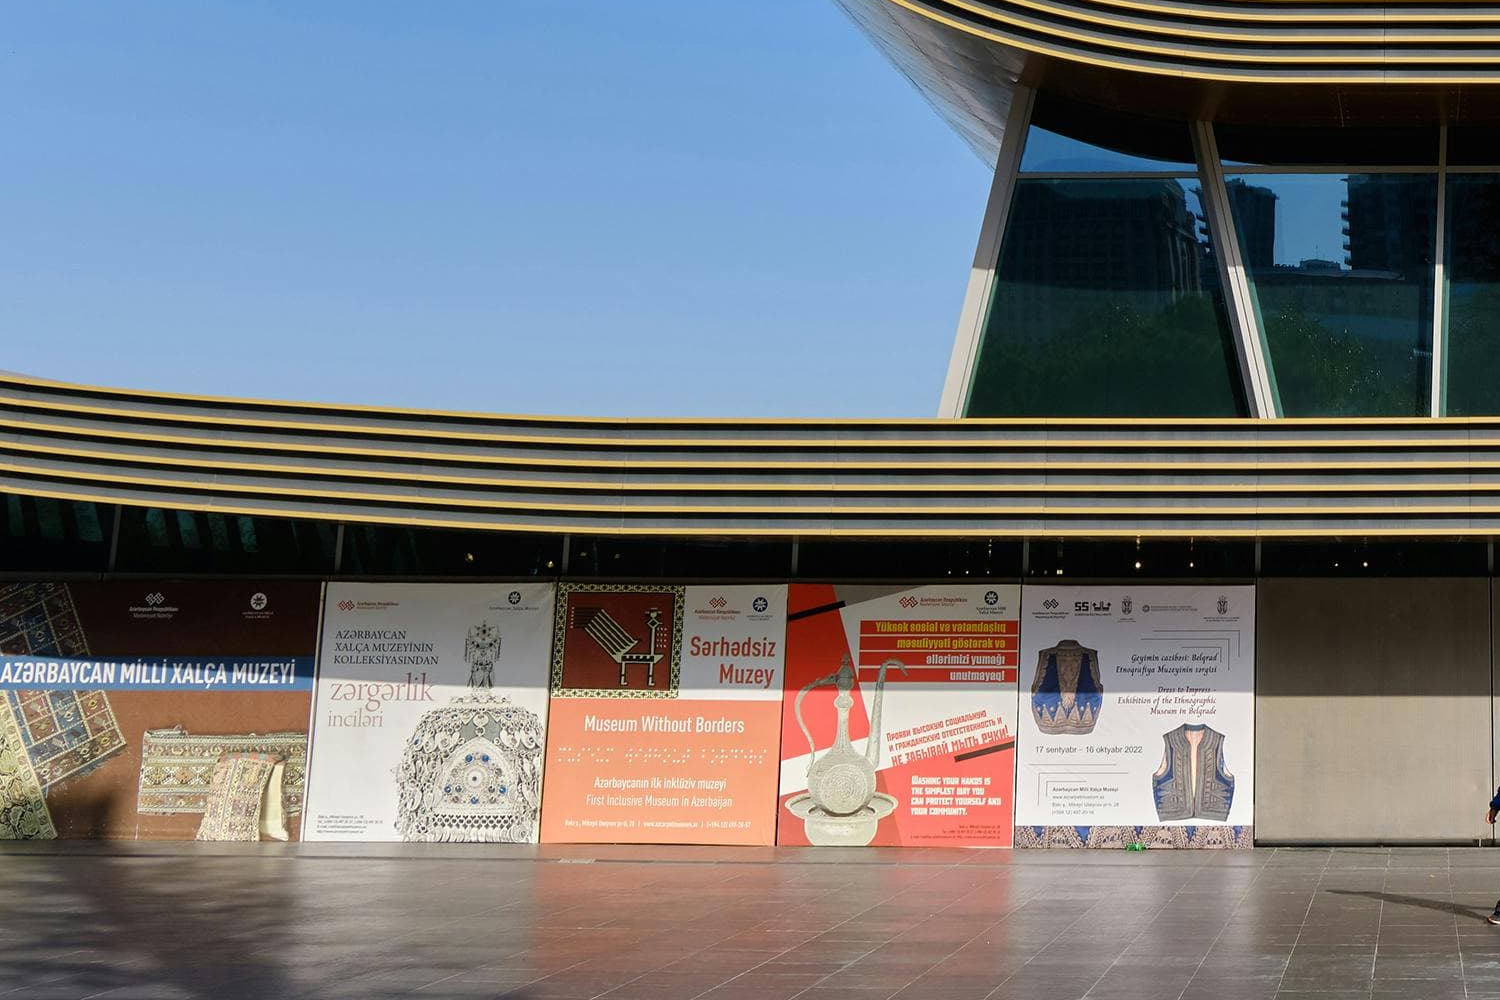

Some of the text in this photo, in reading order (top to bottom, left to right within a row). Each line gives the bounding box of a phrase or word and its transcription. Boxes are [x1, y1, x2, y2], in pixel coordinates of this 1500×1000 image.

[335, 630, 407, 640] AZƏRBAYCAN
[334, 641, 434, 654] XALÇA MUZEYİNİN
[690, 635, 777, 657] Sərhədsiz
[333, 654, 439, 665] KOLLEKSİYASINDAN
[0, 658, 296, 689] AZƏRBAYCAN MİLLİ XALÇA MUZEYİ
[719, 663, 775, 689] Muzey
[330, 672, 435, 713] zərgərlik
[1185, 686, 1211, 697] Impress
[1117, 696, 1151, 705] Exhibition
[1152, 696, 1160, 709] of
[1162, 696, 1173, 704] the
[328, 706, 384, 728] inciləri
[1150, 707, 1178, 715] Museum
[1179, 707, 1187, 715] in
[584, 714, 745, 733] Museum Without Borders
[950, 735, 979, 752] МЫТЬ
[1035, 745, 1044, 754] 17
[1046, 746, 1078, 755] sentyabr
[1095, 745, 1123, 755] oktyabr
[1124, 745, 1143, 754] 2022
[697, 778, 727, 792] muzeyi
[586, 794, 733, 810] First Inclusive Museum in Azerbaijan
